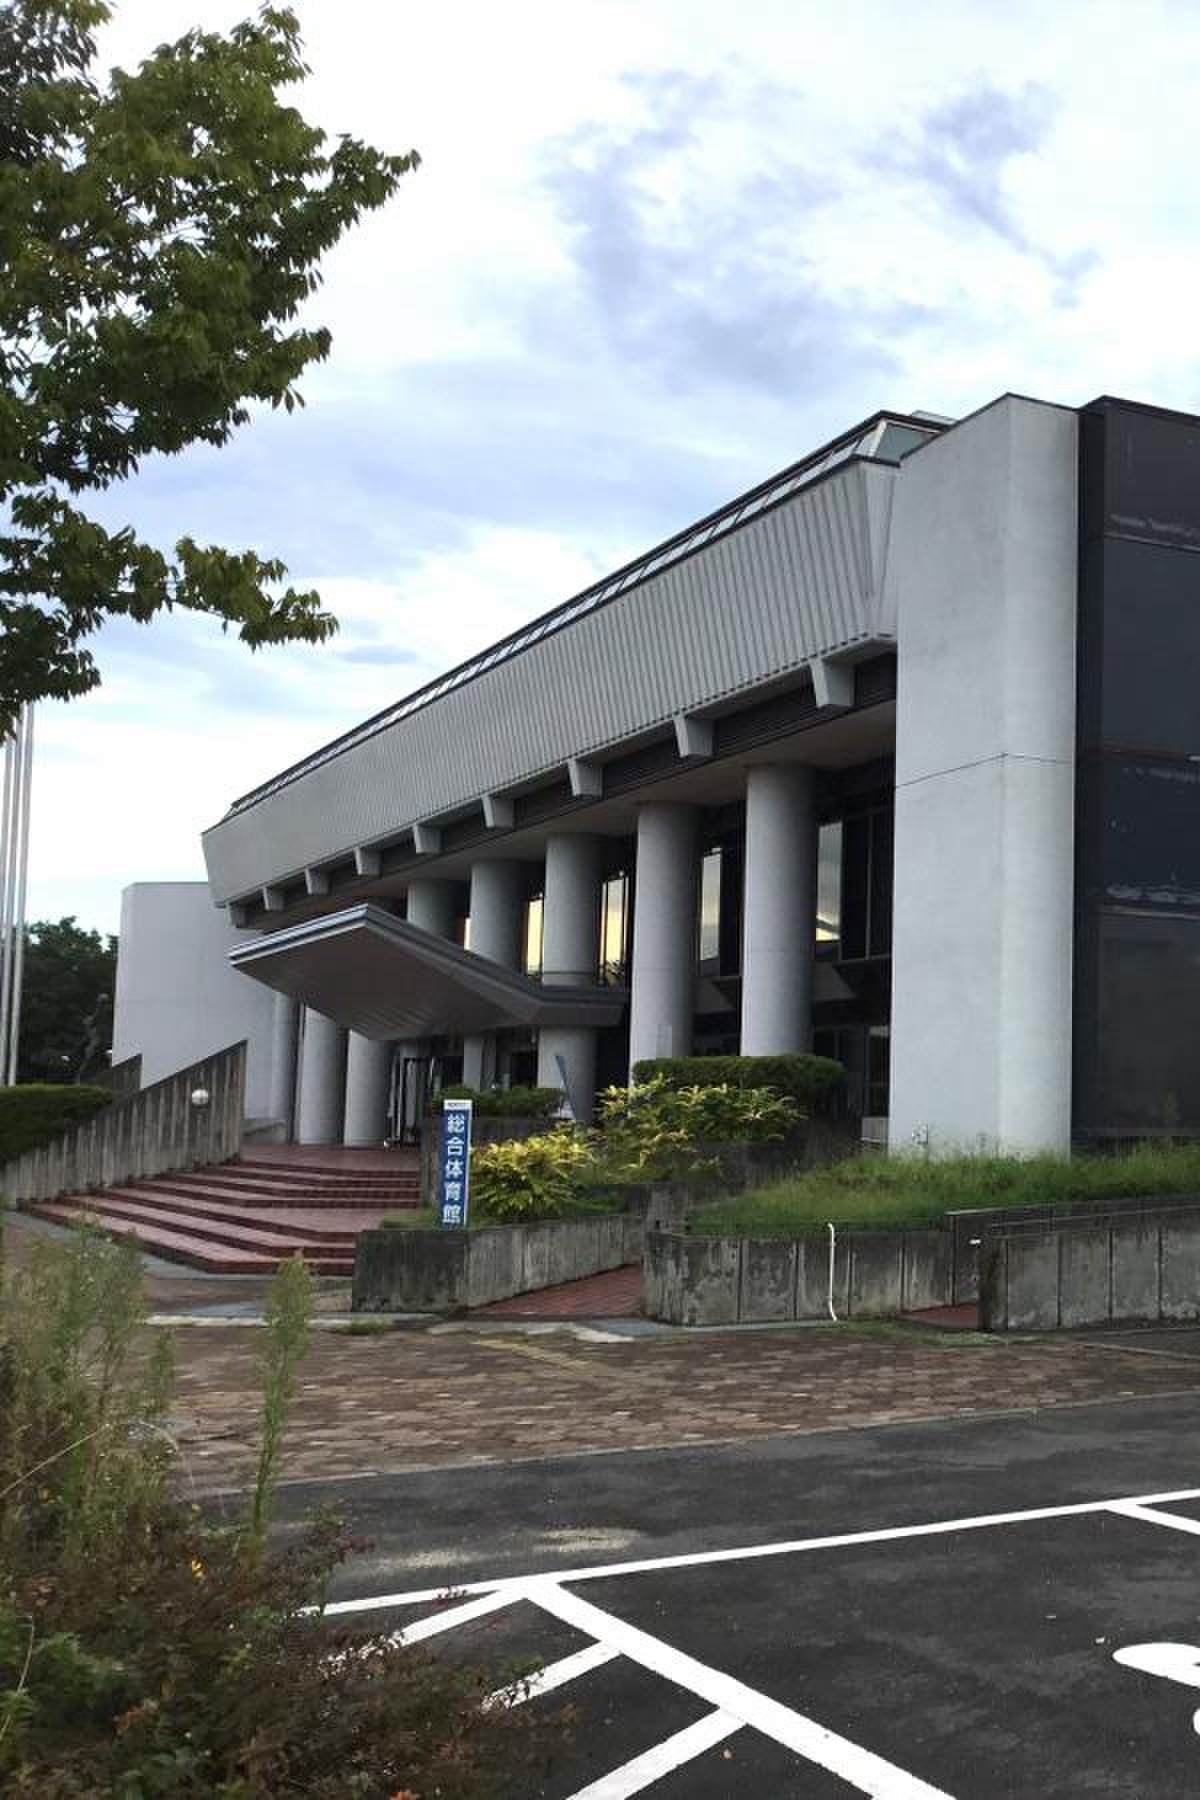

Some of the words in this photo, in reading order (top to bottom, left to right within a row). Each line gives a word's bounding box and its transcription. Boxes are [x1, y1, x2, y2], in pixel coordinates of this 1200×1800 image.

[442, 1113, 464, 1224] 総合体育館
